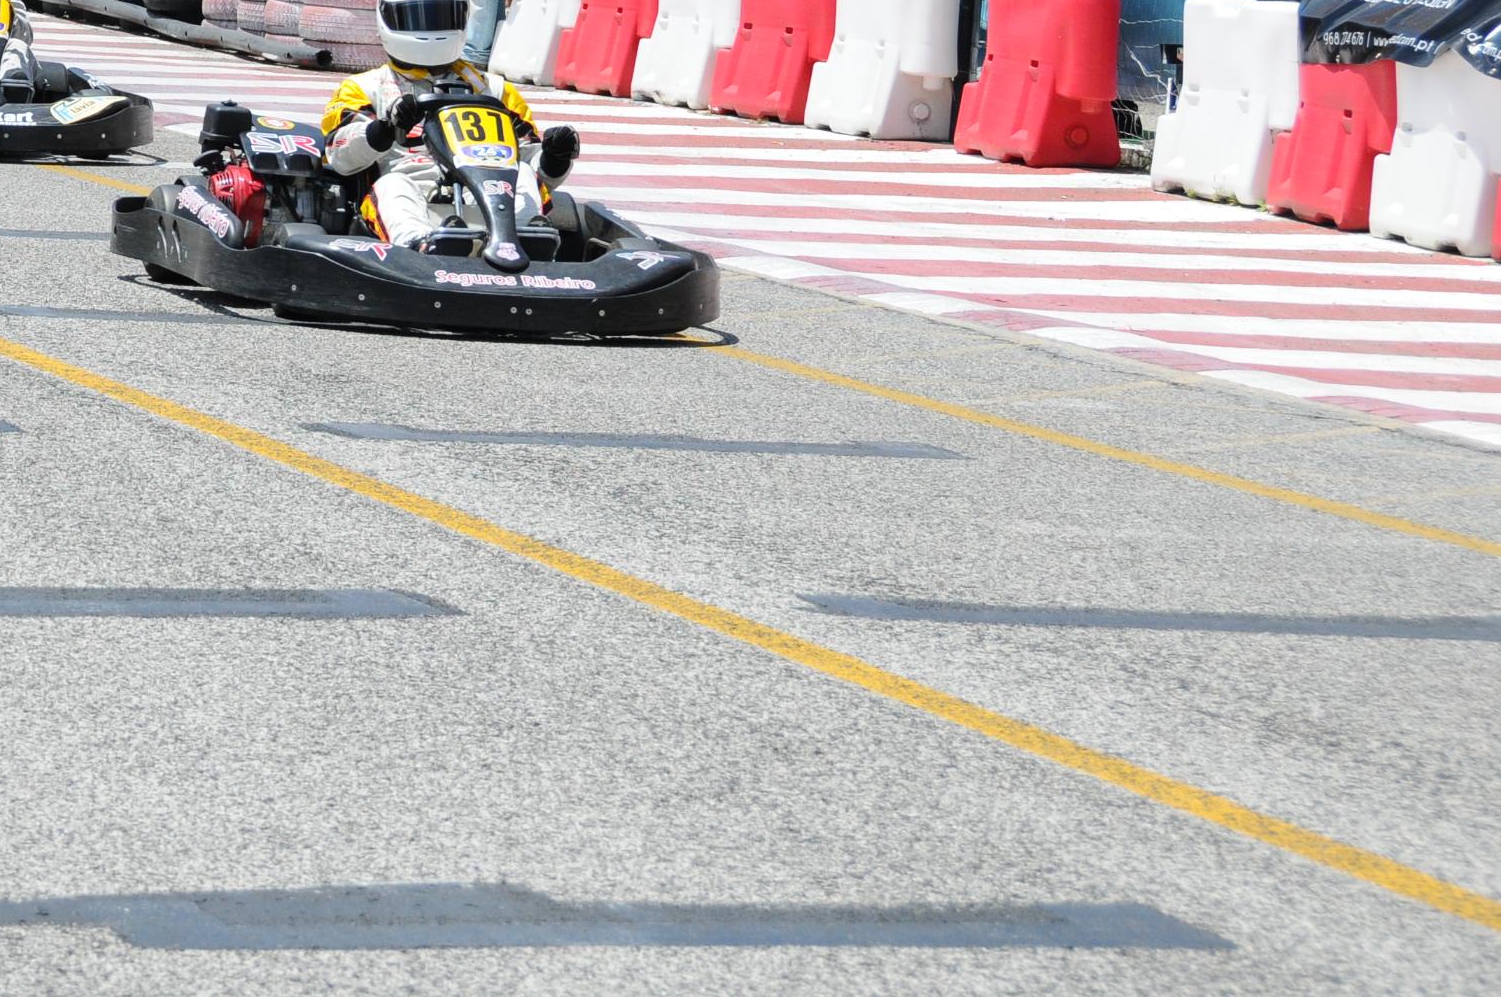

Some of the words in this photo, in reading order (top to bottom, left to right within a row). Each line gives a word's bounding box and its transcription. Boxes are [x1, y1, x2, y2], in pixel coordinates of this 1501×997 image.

[444, 110, 505, 142] 137
[246, 131, 322, 158] SR
[434, 269, 517, 288] Seguros
[521, 274, 596, 291] Ribeiro
